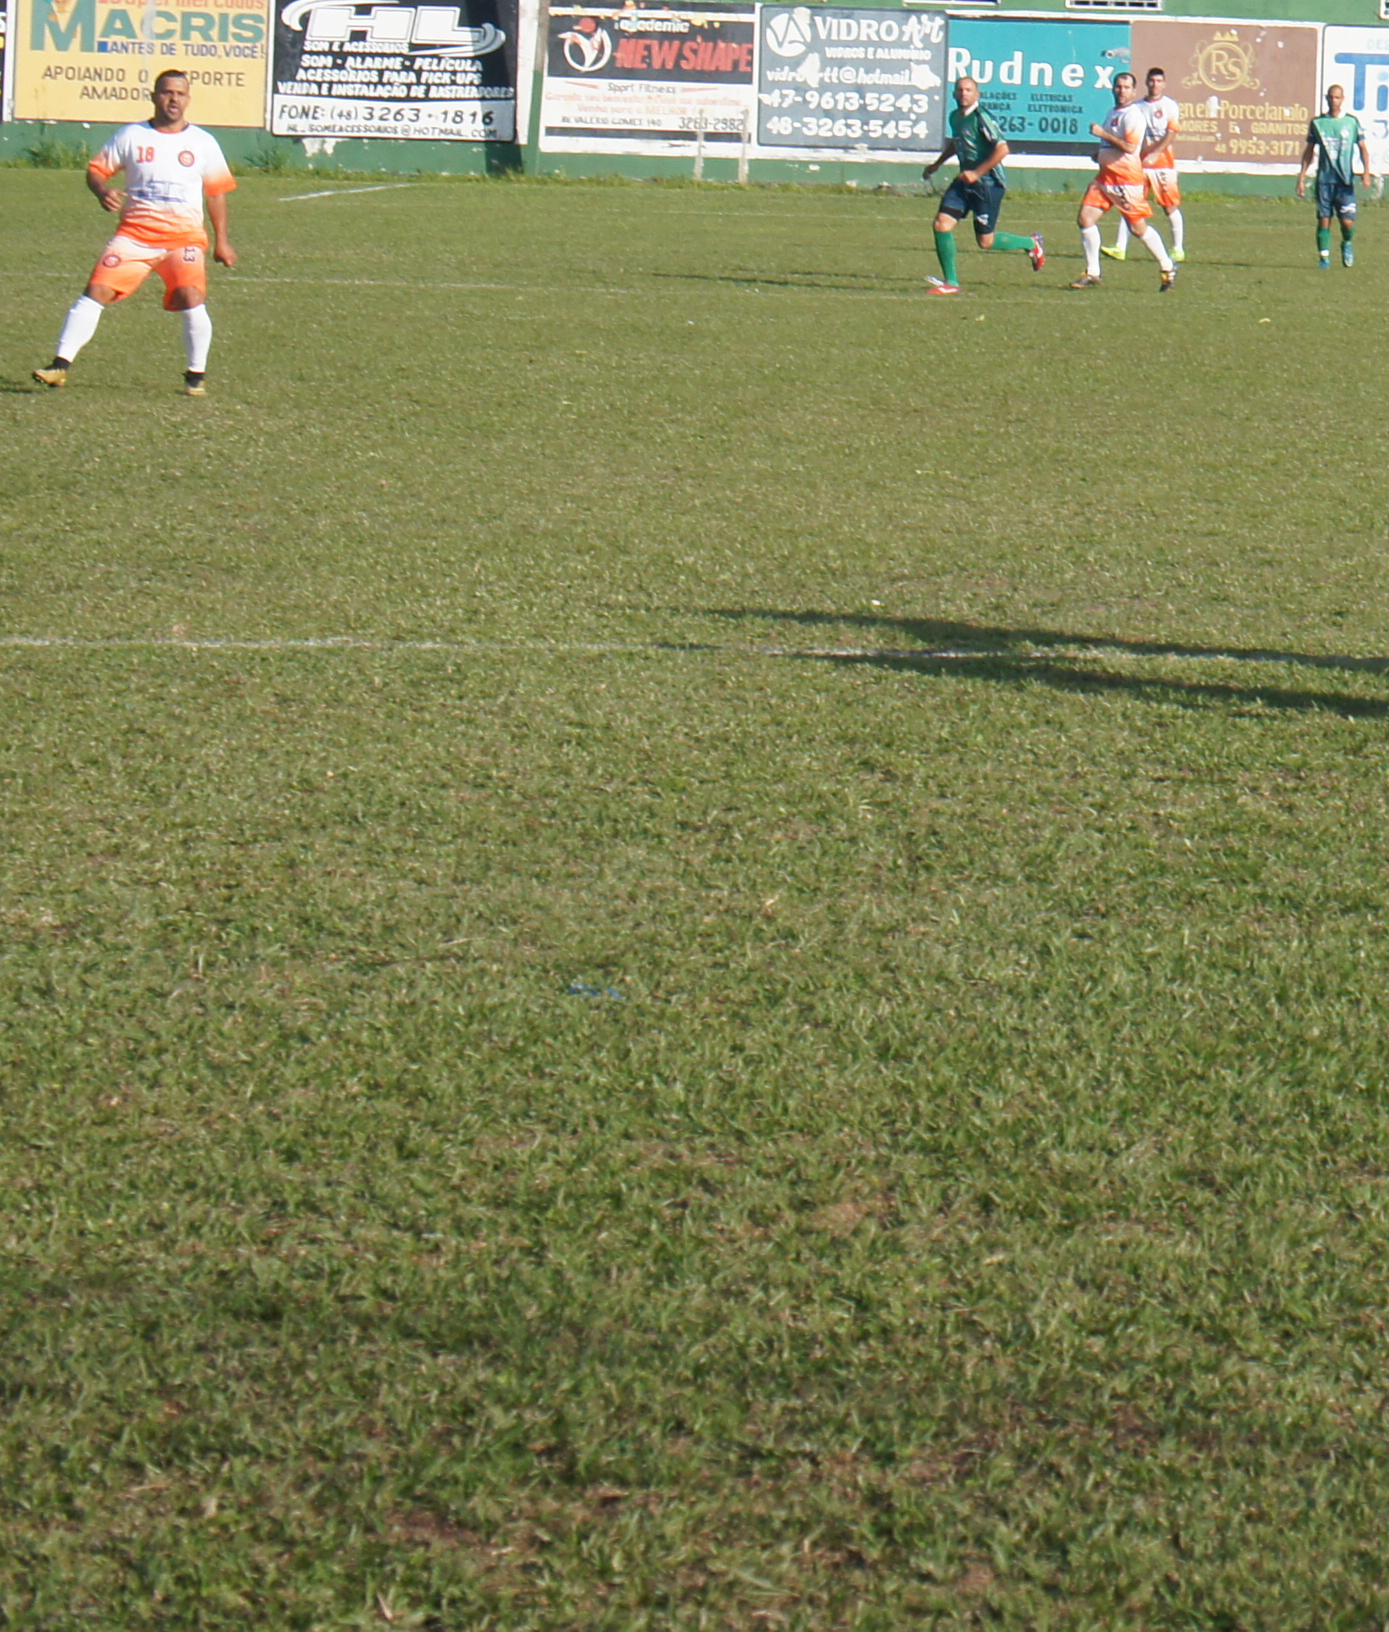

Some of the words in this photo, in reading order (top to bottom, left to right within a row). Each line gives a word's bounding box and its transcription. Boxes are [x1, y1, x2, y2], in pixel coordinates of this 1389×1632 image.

[813, 15, 900, 42] VIDRO
[108, 41, 155, 55] ANTES
[160, 42, 177, 56] DE
[303, 41, 329, 52] SOM
[614, 38, 680, 70] NEW
[680, 39, 755, 72] SHAPE
[300, 54, 333, 68] SOM
[345, 55, 403, 70] ALARME
[948, 47, 1115, 90] Rudnex
[1210, 49, 1242, 81] RS
[42, 65, 126, 82] APOIANDO
[138, 68, 149, 84] O
[382, 69, 418, 84] PARA
[420, 71, 483, 85] PICK-UPS
[80, 85, 153, 102] AMADOR
[277, 81, 319, 95] VENDA
[320, 83, 330, 96] E
[409, 86, 426, 98] DE
[279, 104, 325, 120] FONE:
[1251, 122, 1309, 135] GRANITOS
[136, 146, 155, 164] 18
